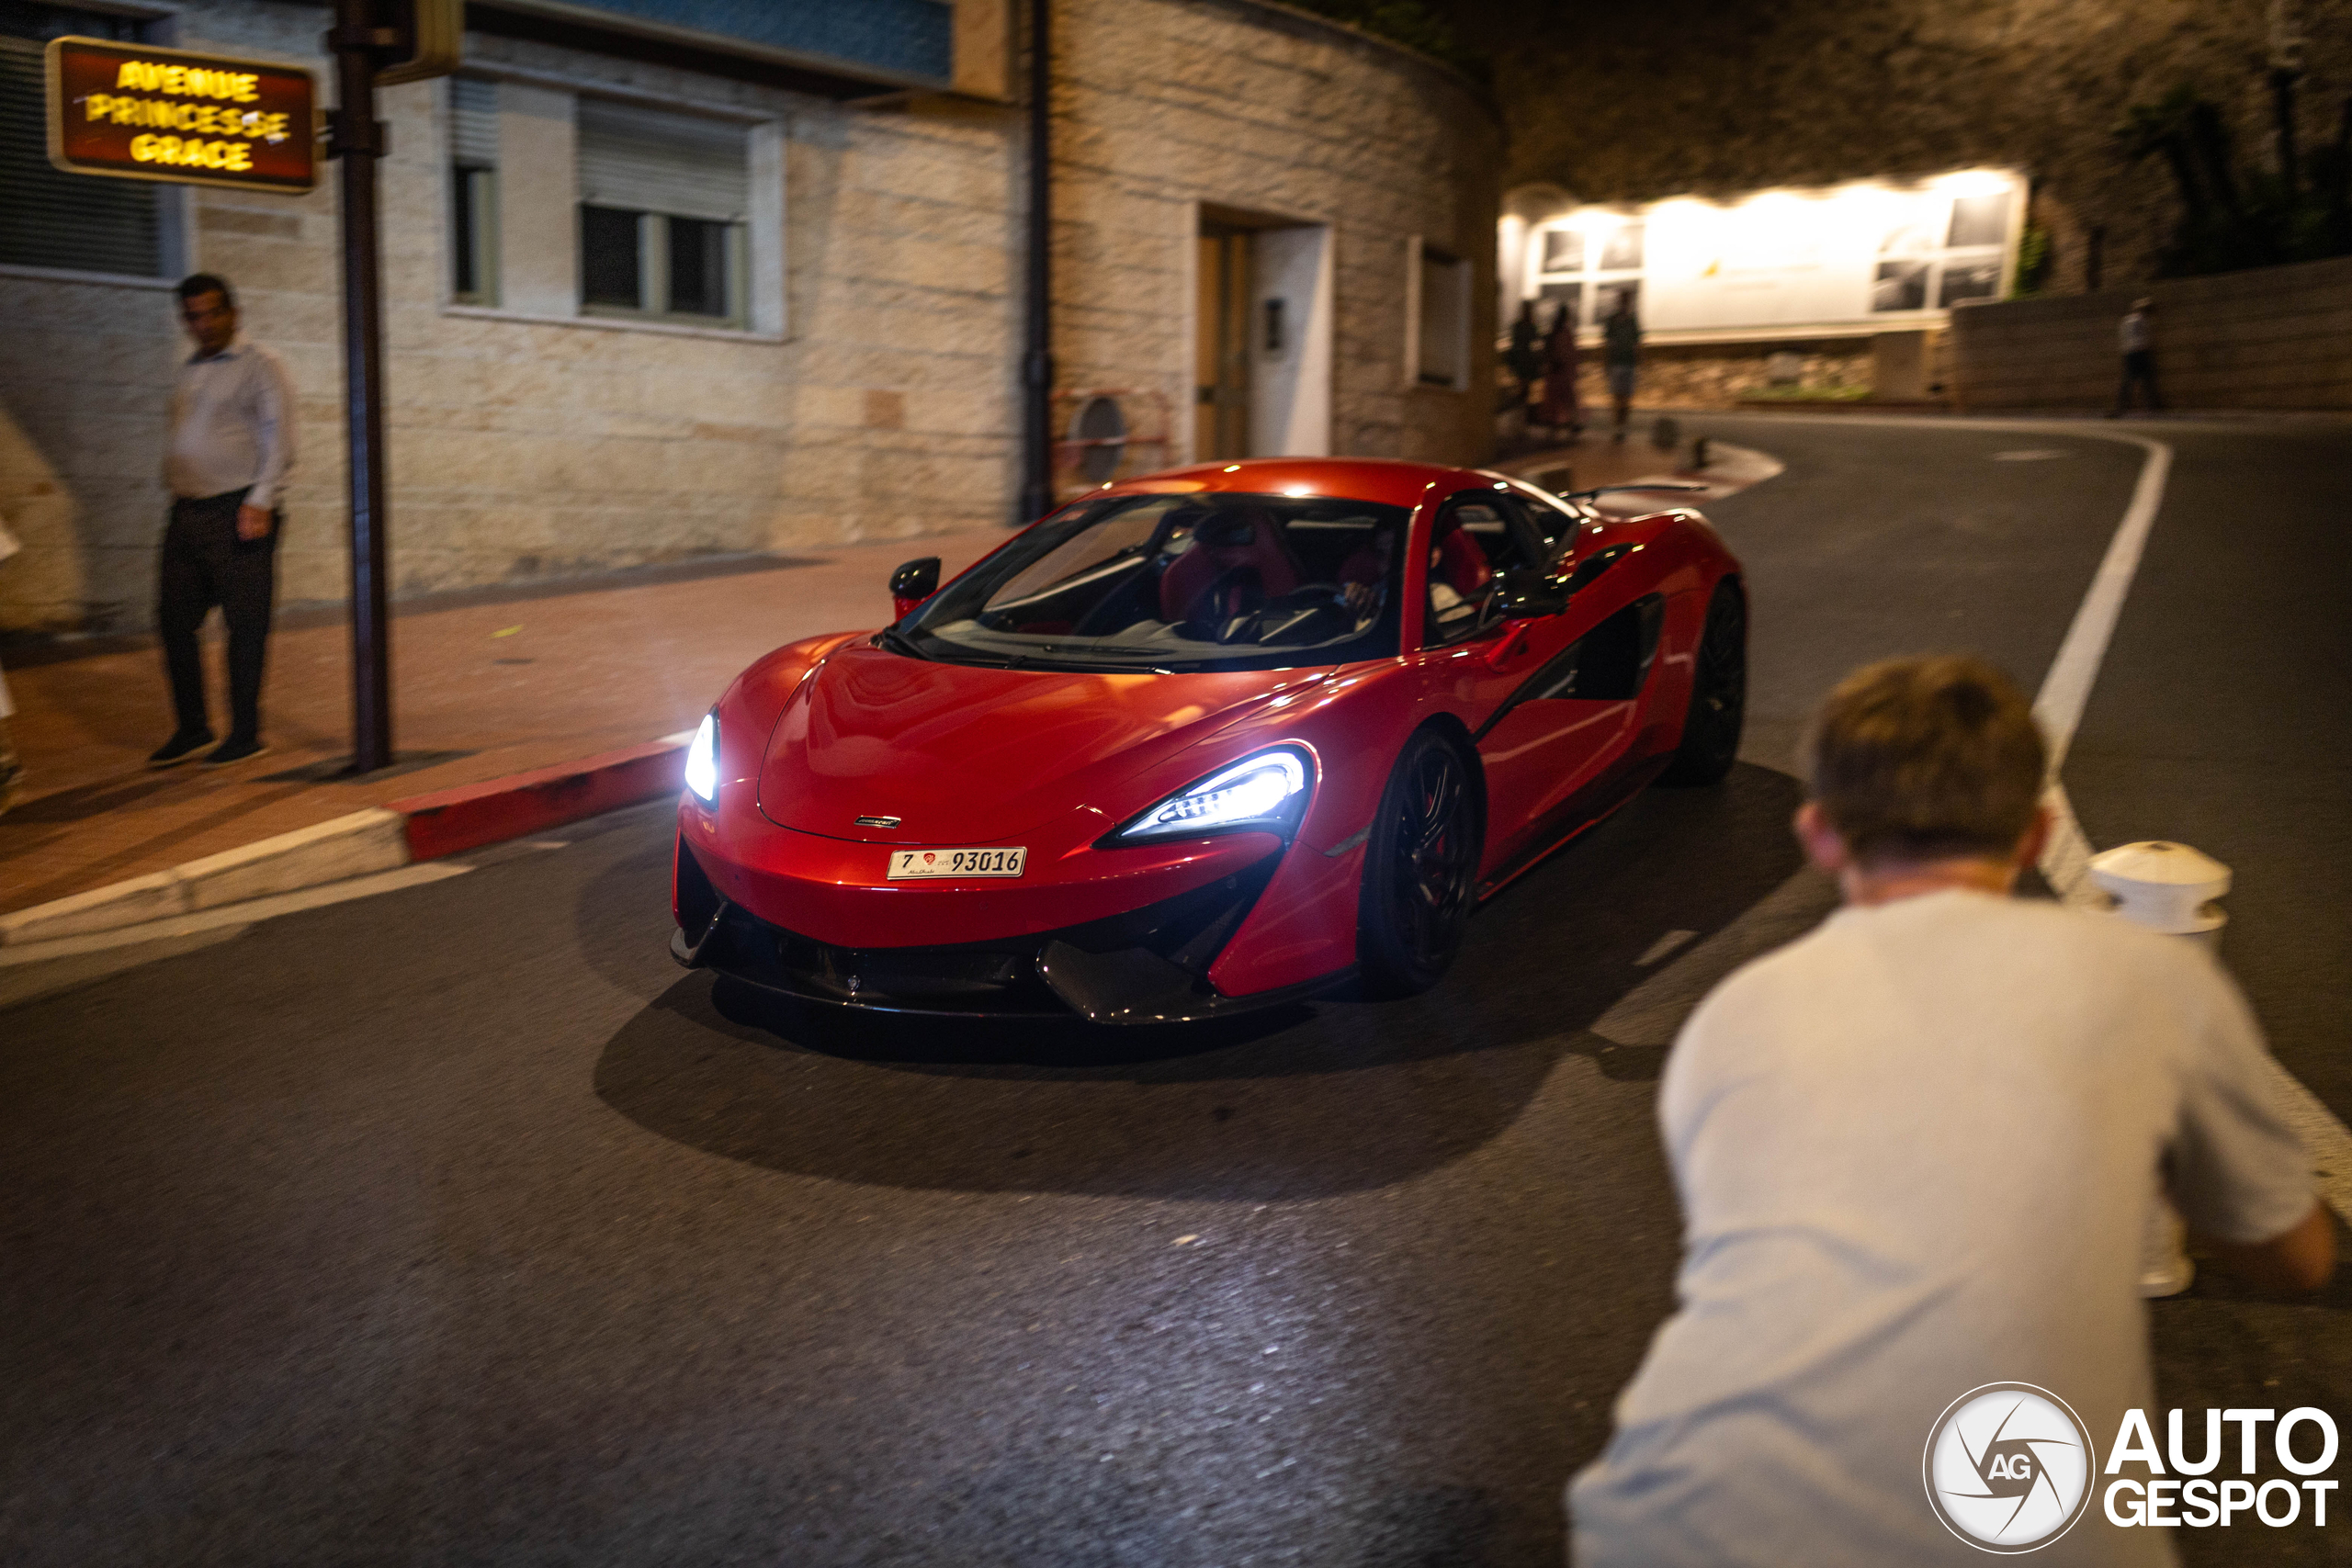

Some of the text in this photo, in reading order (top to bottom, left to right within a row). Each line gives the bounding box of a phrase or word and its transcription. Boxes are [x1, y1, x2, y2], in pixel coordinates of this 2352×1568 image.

[116, 61, 260, 103] AVENUE
[85, 94, 290, 140] PRINCESSE
[130, 133, 254, 172] GRACE
[902, 852, 1019, 872] 7 93016
